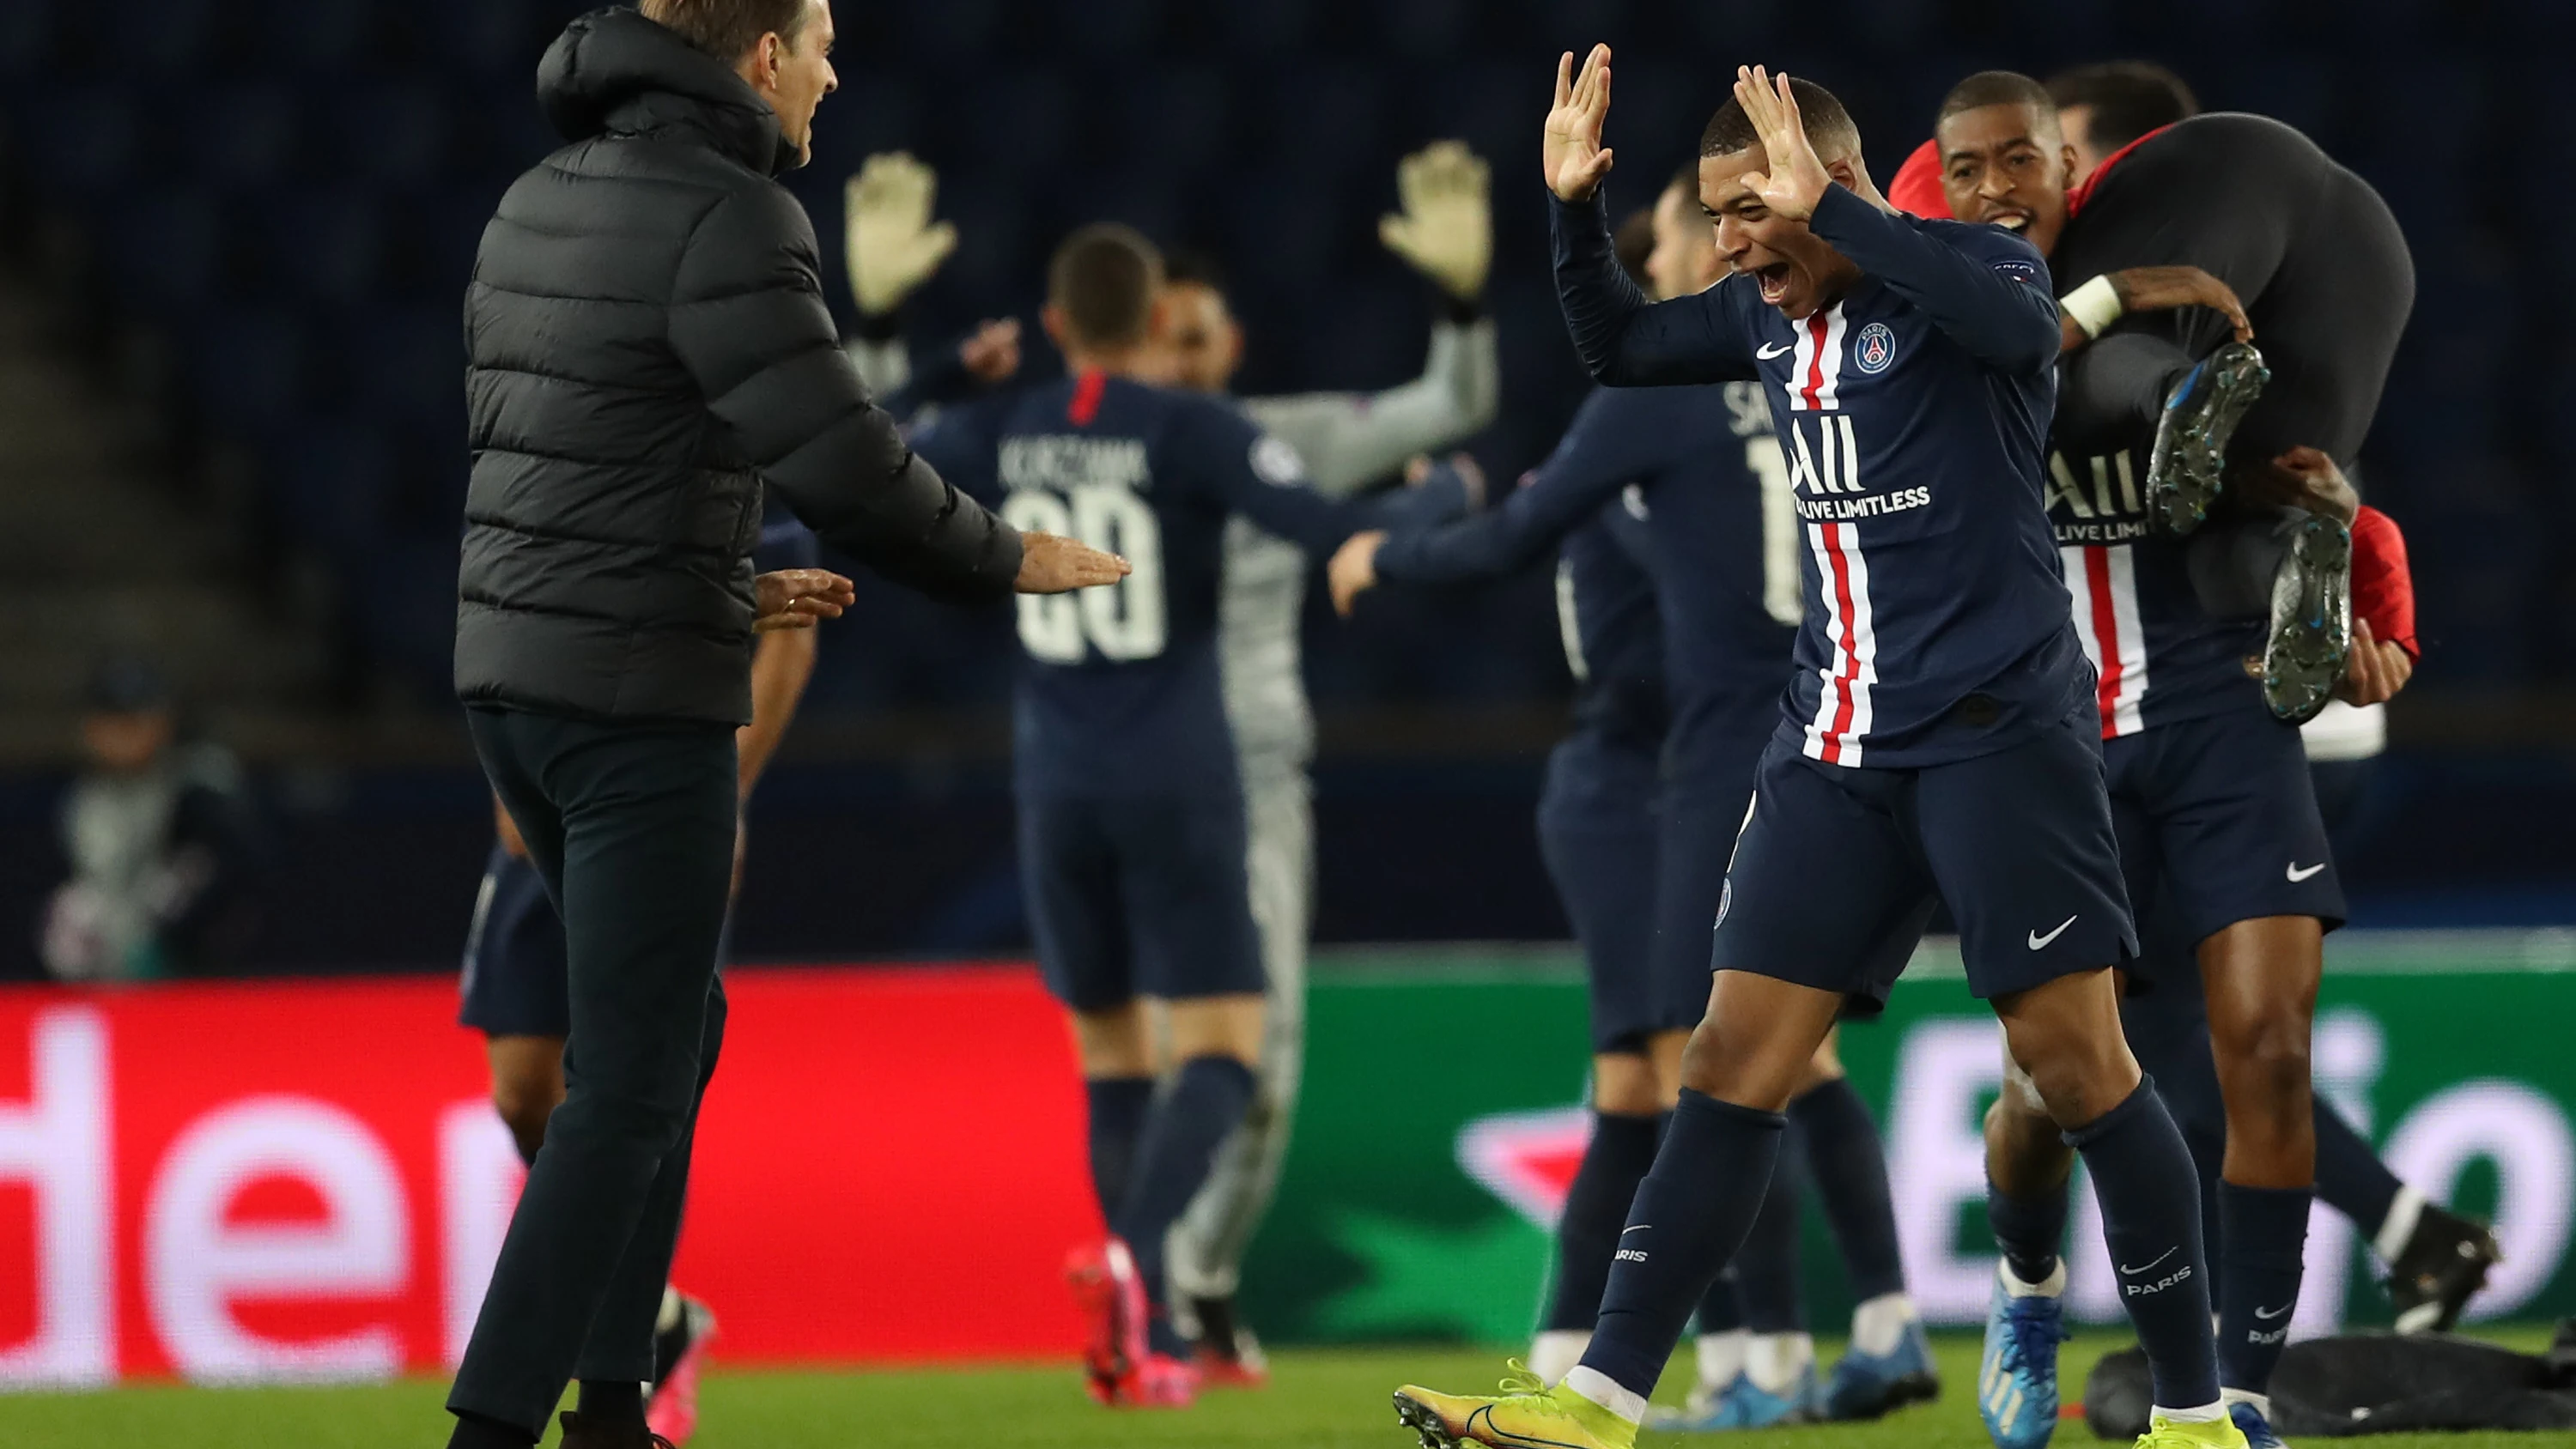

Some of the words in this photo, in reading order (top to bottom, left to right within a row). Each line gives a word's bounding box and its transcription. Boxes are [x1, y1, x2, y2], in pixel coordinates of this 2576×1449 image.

[1861, 325, 1887, 340] PARIS
[1802, 500, 1835, 519] LIVE
[1834, 486, 1931, 518] LIMITLESS
[2053, 524, 2101, 541] LIVE
[2127, 1265, 2192, 1296] PARIS
